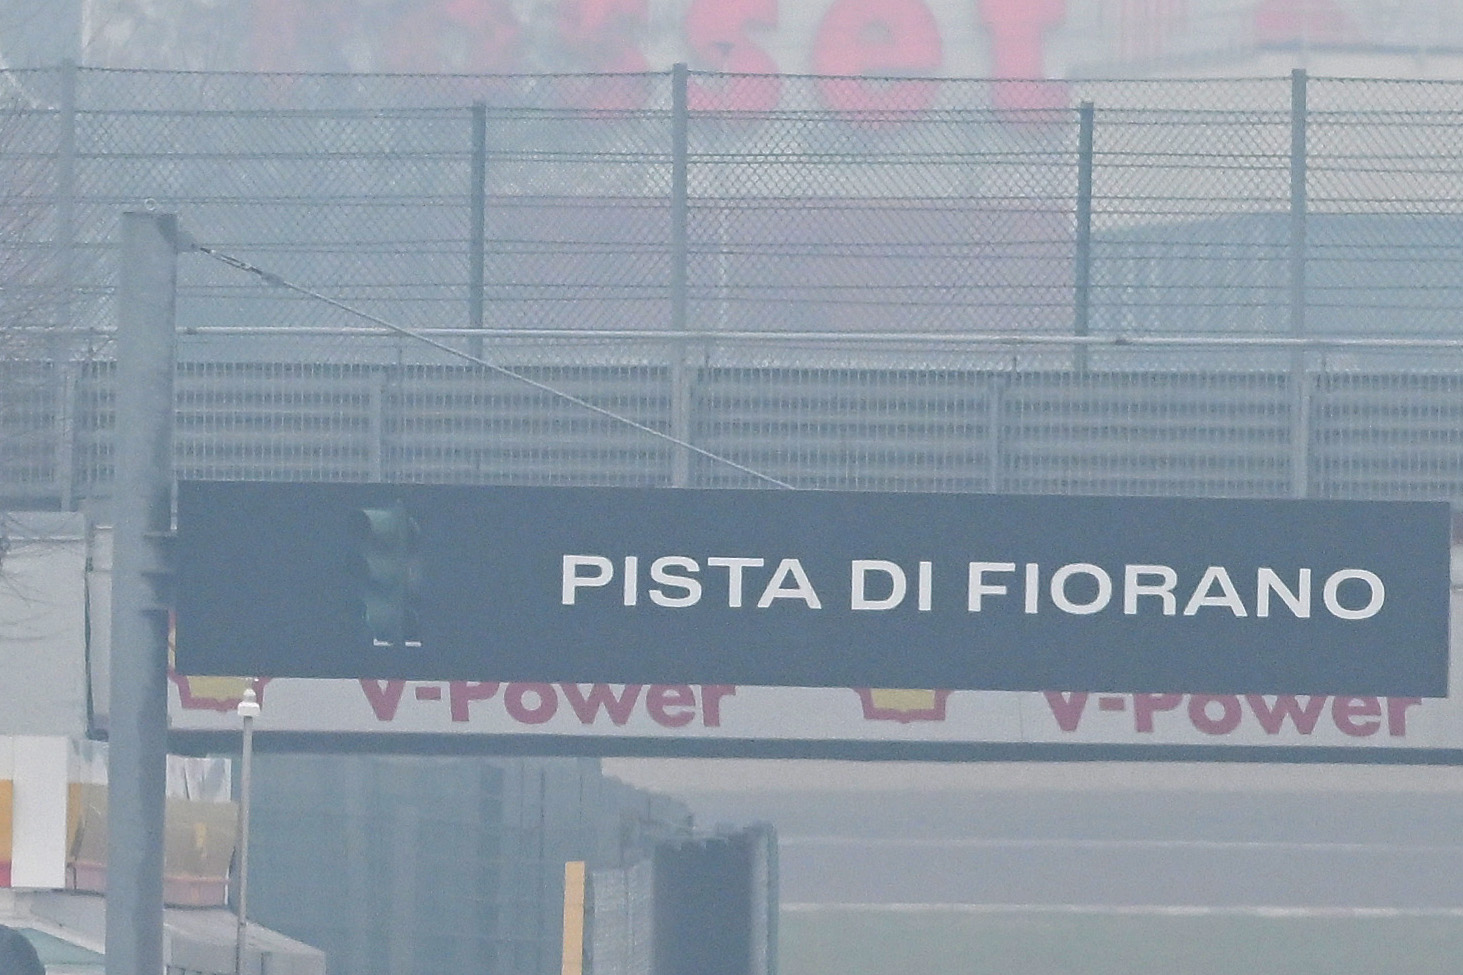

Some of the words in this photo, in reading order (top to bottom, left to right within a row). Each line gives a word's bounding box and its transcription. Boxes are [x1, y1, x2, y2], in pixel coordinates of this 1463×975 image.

[561, 554, 822, 610] PISTA
[850, 558, 932, 611] DI
[967, 560, 1386, 620] FIORANO
